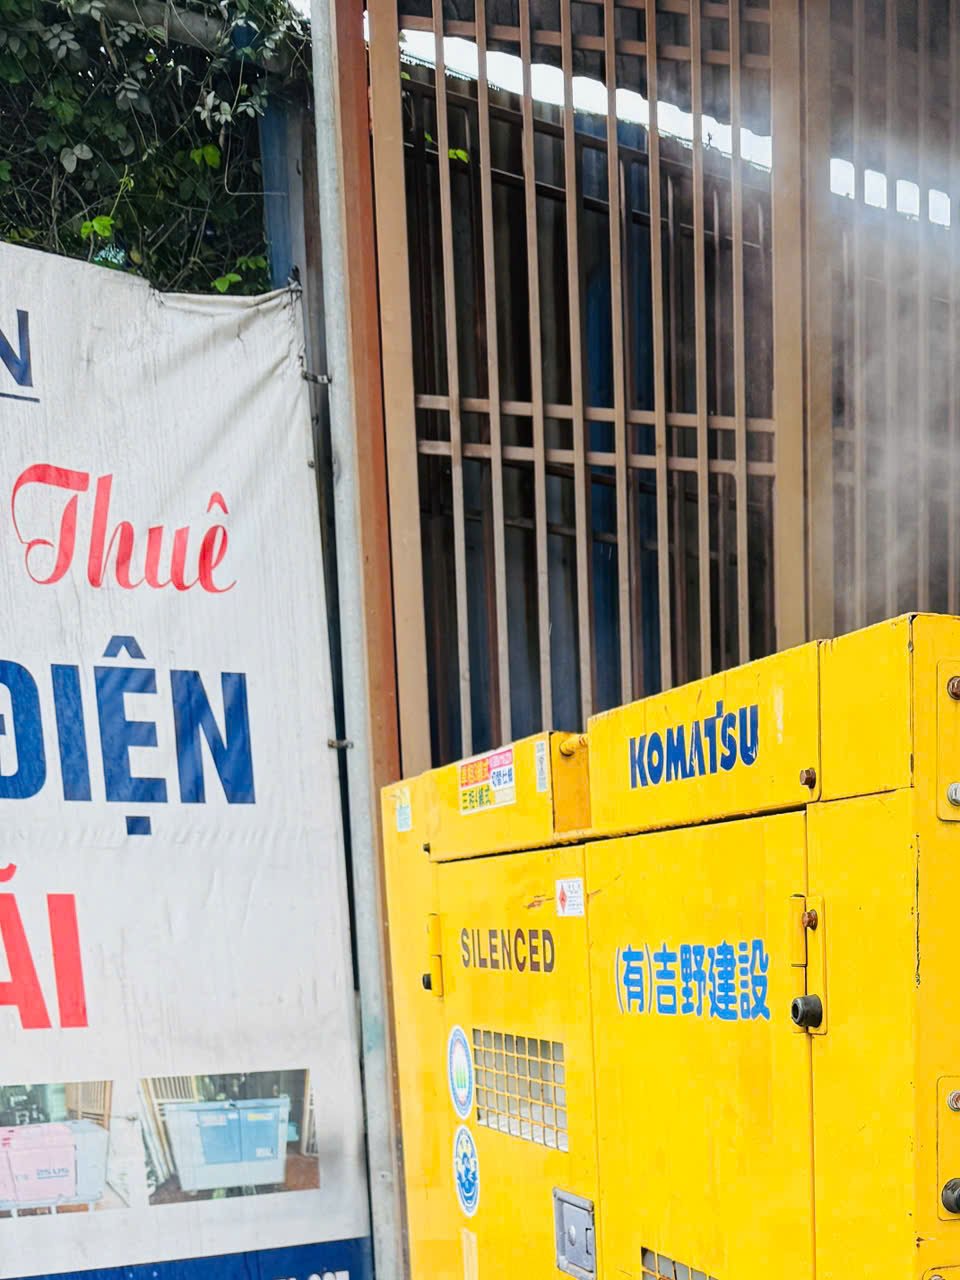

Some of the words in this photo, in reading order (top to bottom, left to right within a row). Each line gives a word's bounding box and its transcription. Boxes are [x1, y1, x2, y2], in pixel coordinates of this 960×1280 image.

[11, 463, 238, 593] Thuê
[630, 700, 759, 789] KOMATSU
[460, 928, 555, 973] SILENCED
[615, 939, 771, 1020] (有)吉野建設
